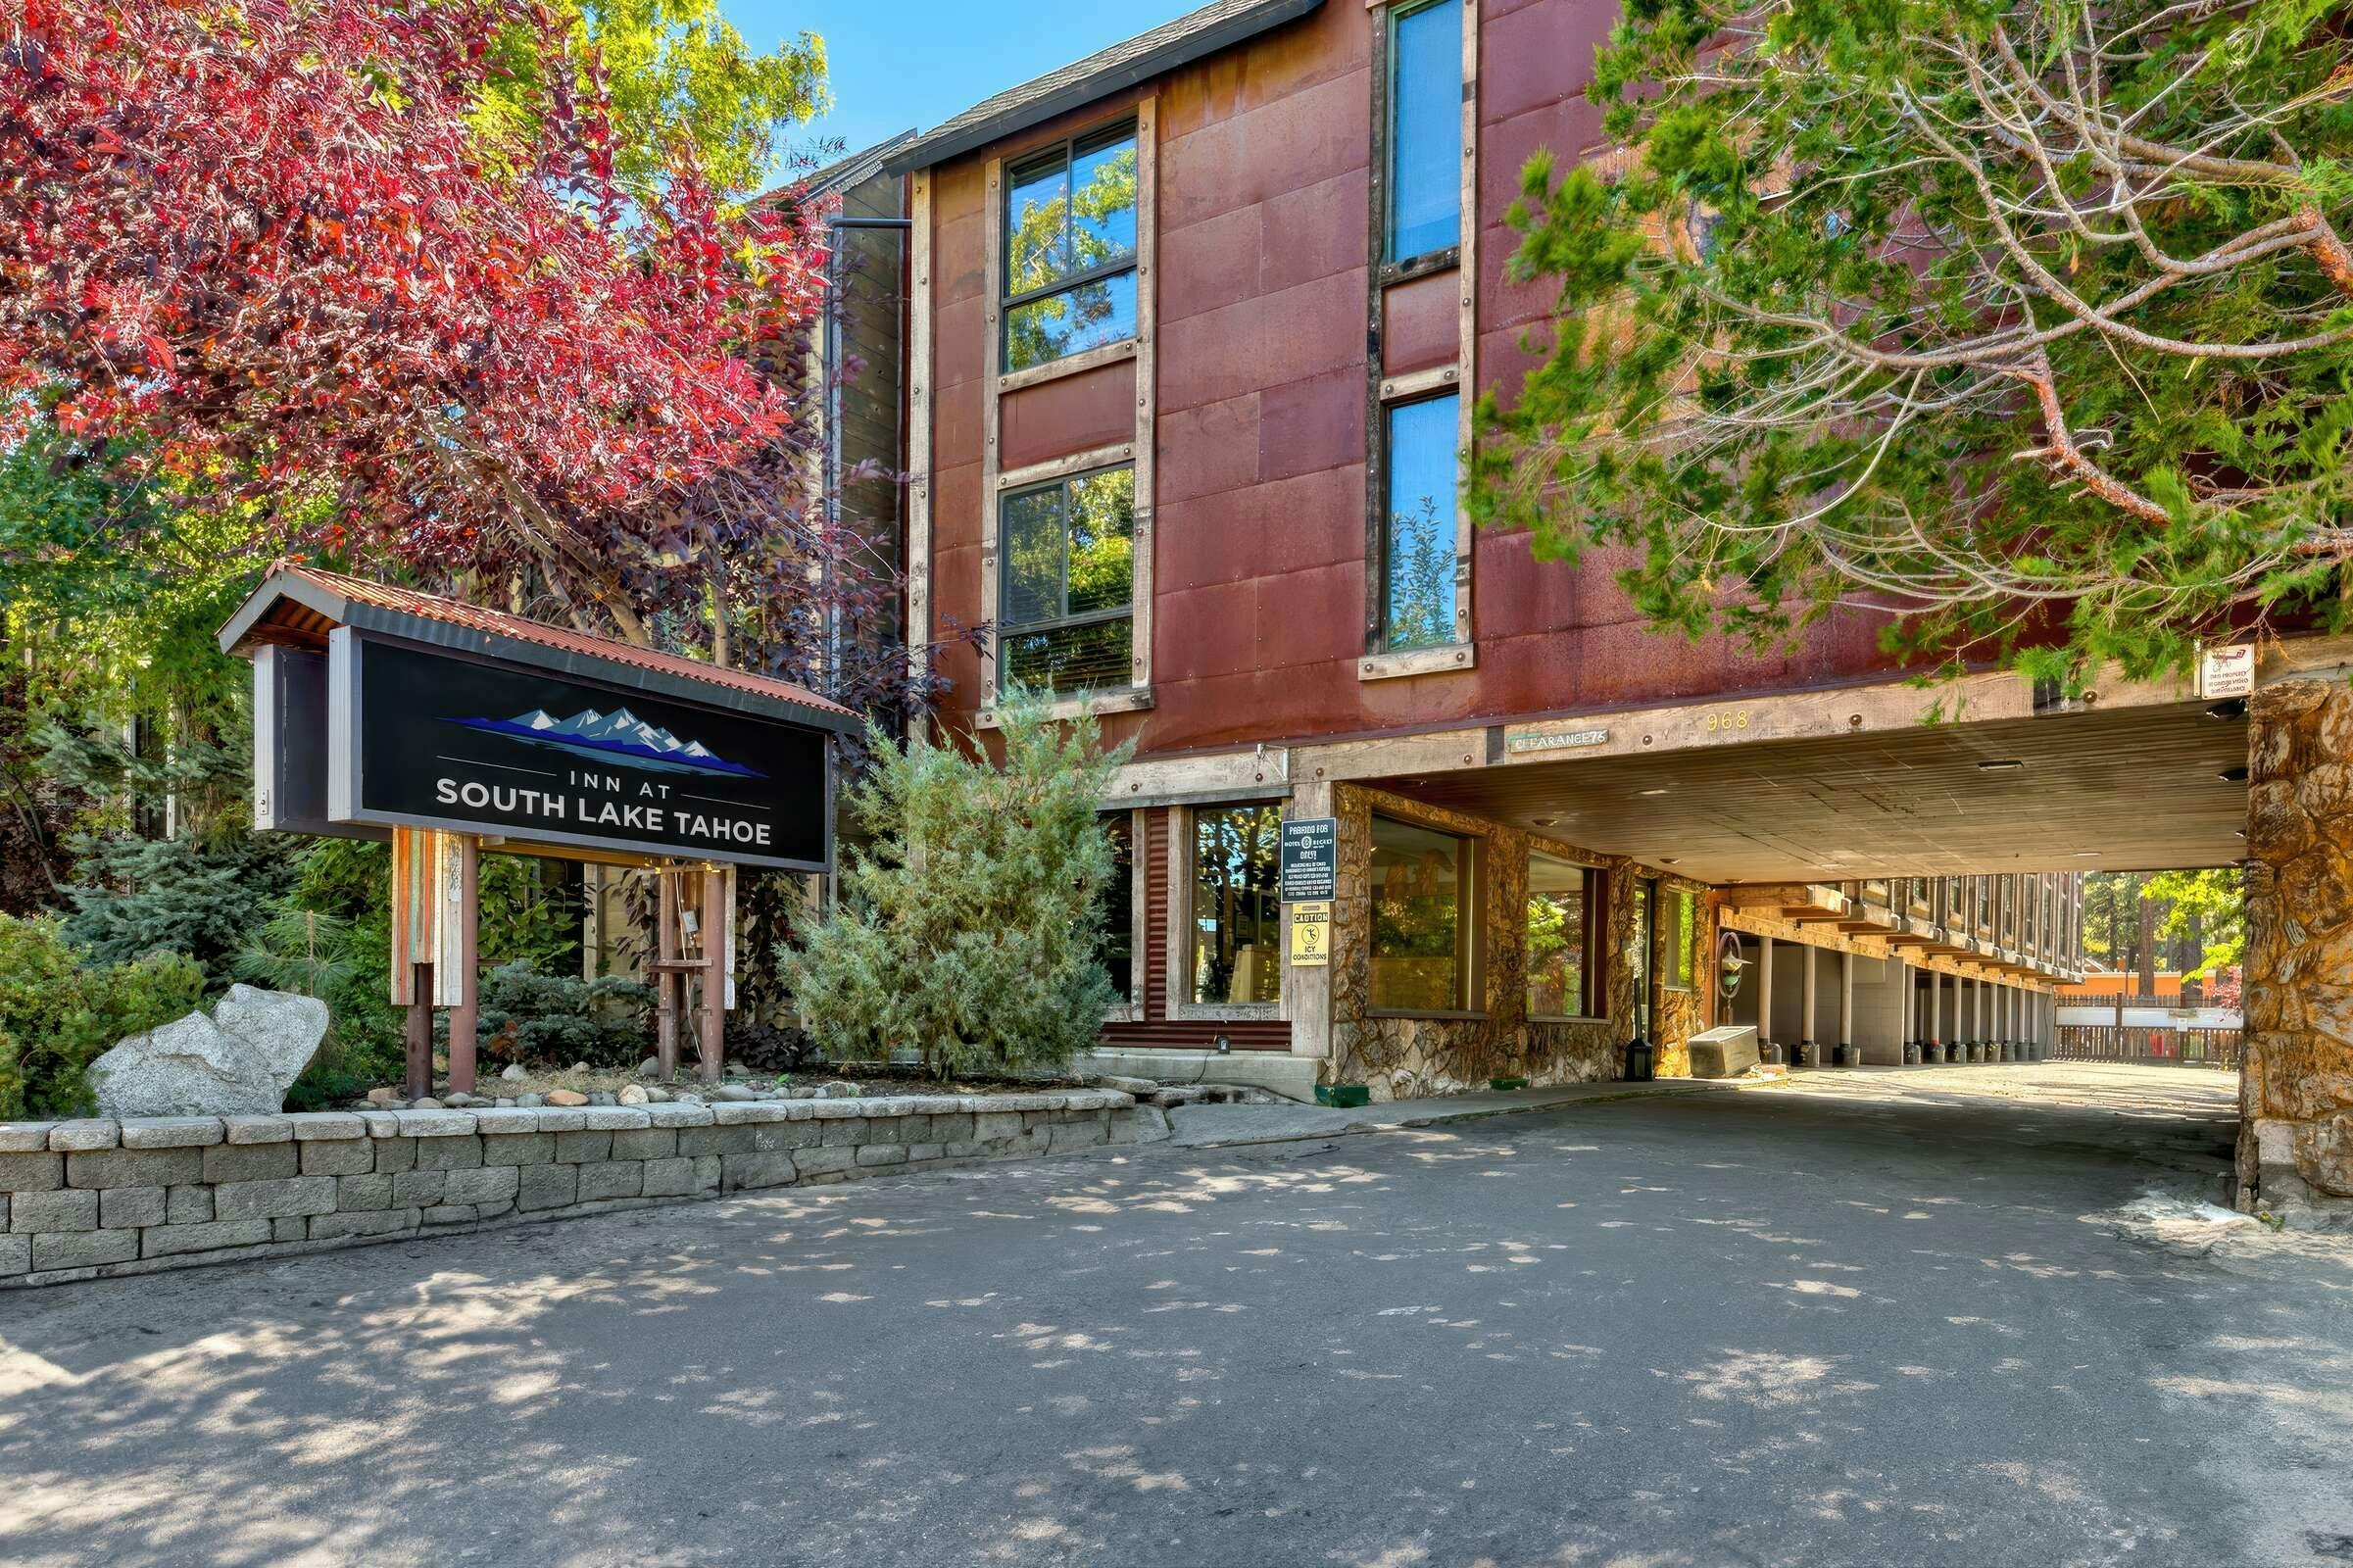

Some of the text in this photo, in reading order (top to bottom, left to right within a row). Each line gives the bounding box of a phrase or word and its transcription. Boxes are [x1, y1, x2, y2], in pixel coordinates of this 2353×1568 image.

[1707, 710, 1747, 731] 968
[570, 770, 670, 800] INN AT
[436, 778, 771, 845] SOUTH LAKE TAHOE
[1294, 912, 1328, 923] CAUTION
